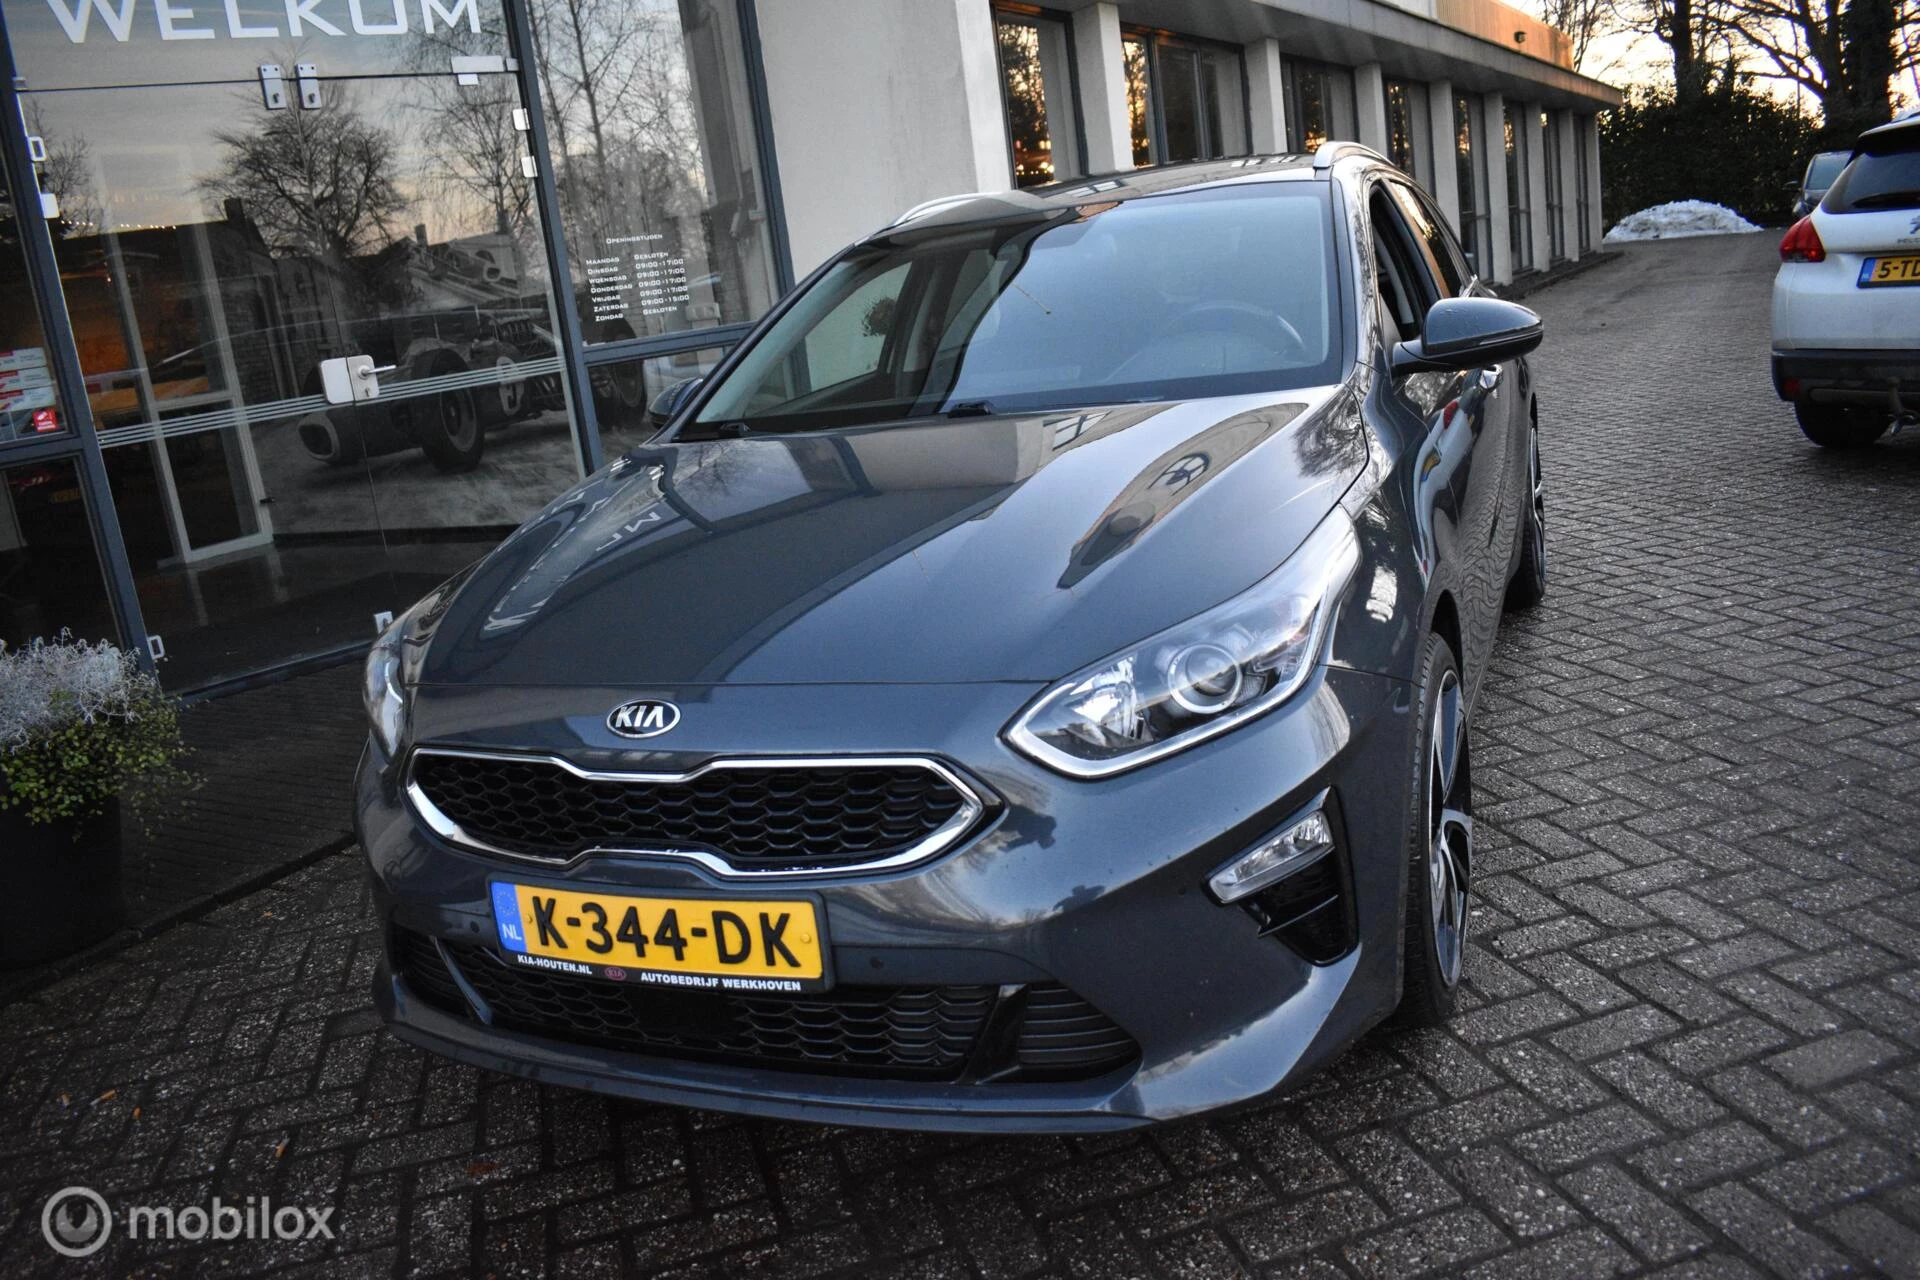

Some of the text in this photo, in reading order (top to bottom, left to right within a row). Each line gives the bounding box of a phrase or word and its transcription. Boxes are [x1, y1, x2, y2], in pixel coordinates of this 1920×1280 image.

[46, 0, 481, 43] WELKOM
[585, 252, 669, 265] MAANDAG GESLOTEN
[587, 266, 618, 275] DINSDAG
[588, 275, 627, 284] WOENSDAG
[591, 284, 633, 293] DONDERDAG
[594, 303, 629, 312] ZATERDAG
[595, 306, 677, 322] ZONDAG GESLOTEN
[615, 705, 664, 728] KIA
[502, 896, 801, 967] NL K-344-DK
[517, 954, 593, 975] KIA-HOUTEN.NL
[641, 972, 802, 991] AUTOBEDRIJF WERKHOVEN
